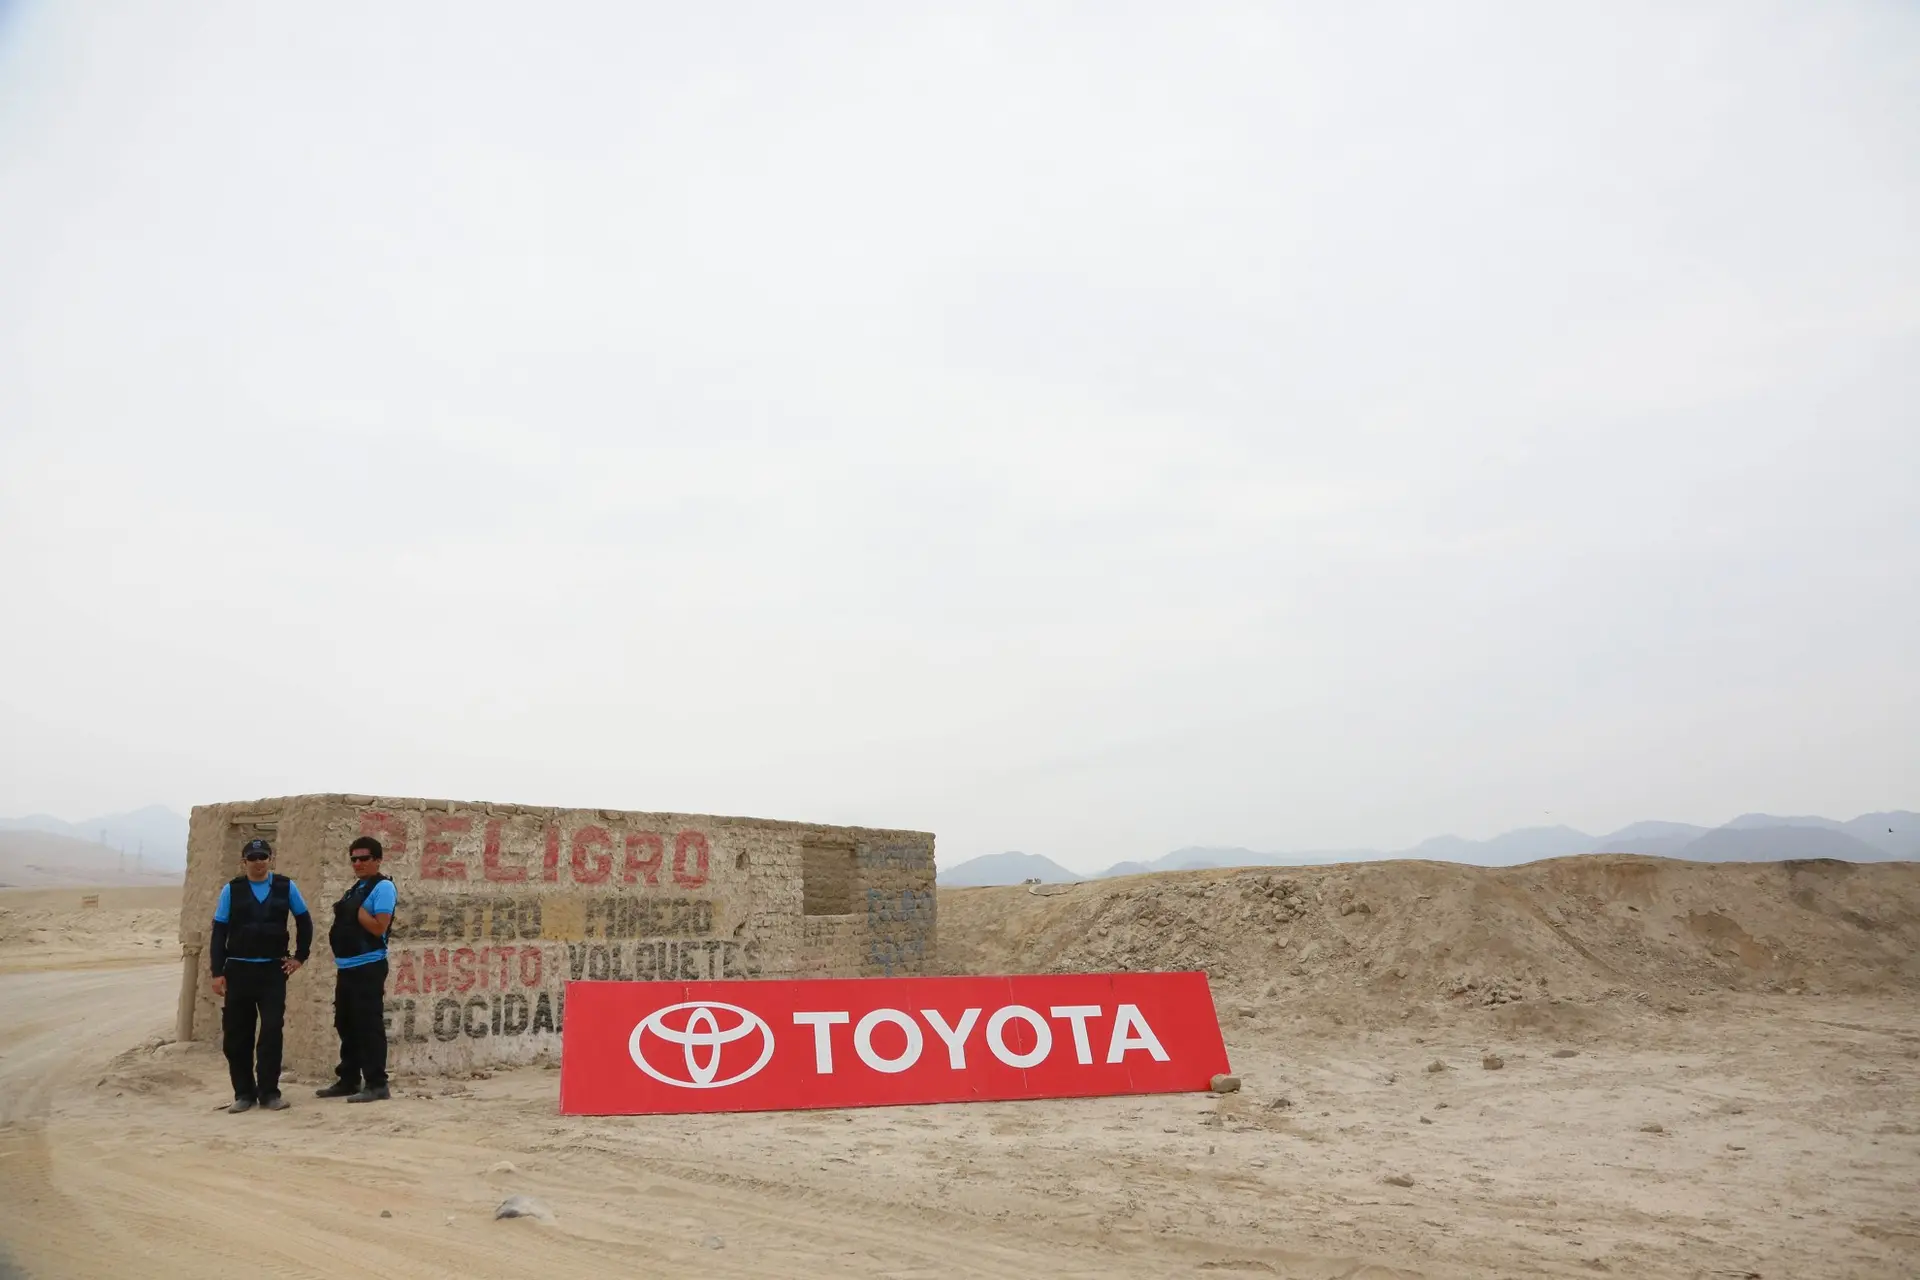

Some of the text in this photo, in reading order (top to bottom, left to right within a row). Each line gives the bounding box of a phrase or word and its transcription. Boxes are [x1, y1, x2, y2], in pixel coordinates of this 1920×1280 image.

[360, 812, 710, 889] PELIGRO
[388, 945, 543, 996] ANSITO
[383, 991, 563, 1044] ELOCIDA
[793, 1003, 1170, 1075] TOYOTA
